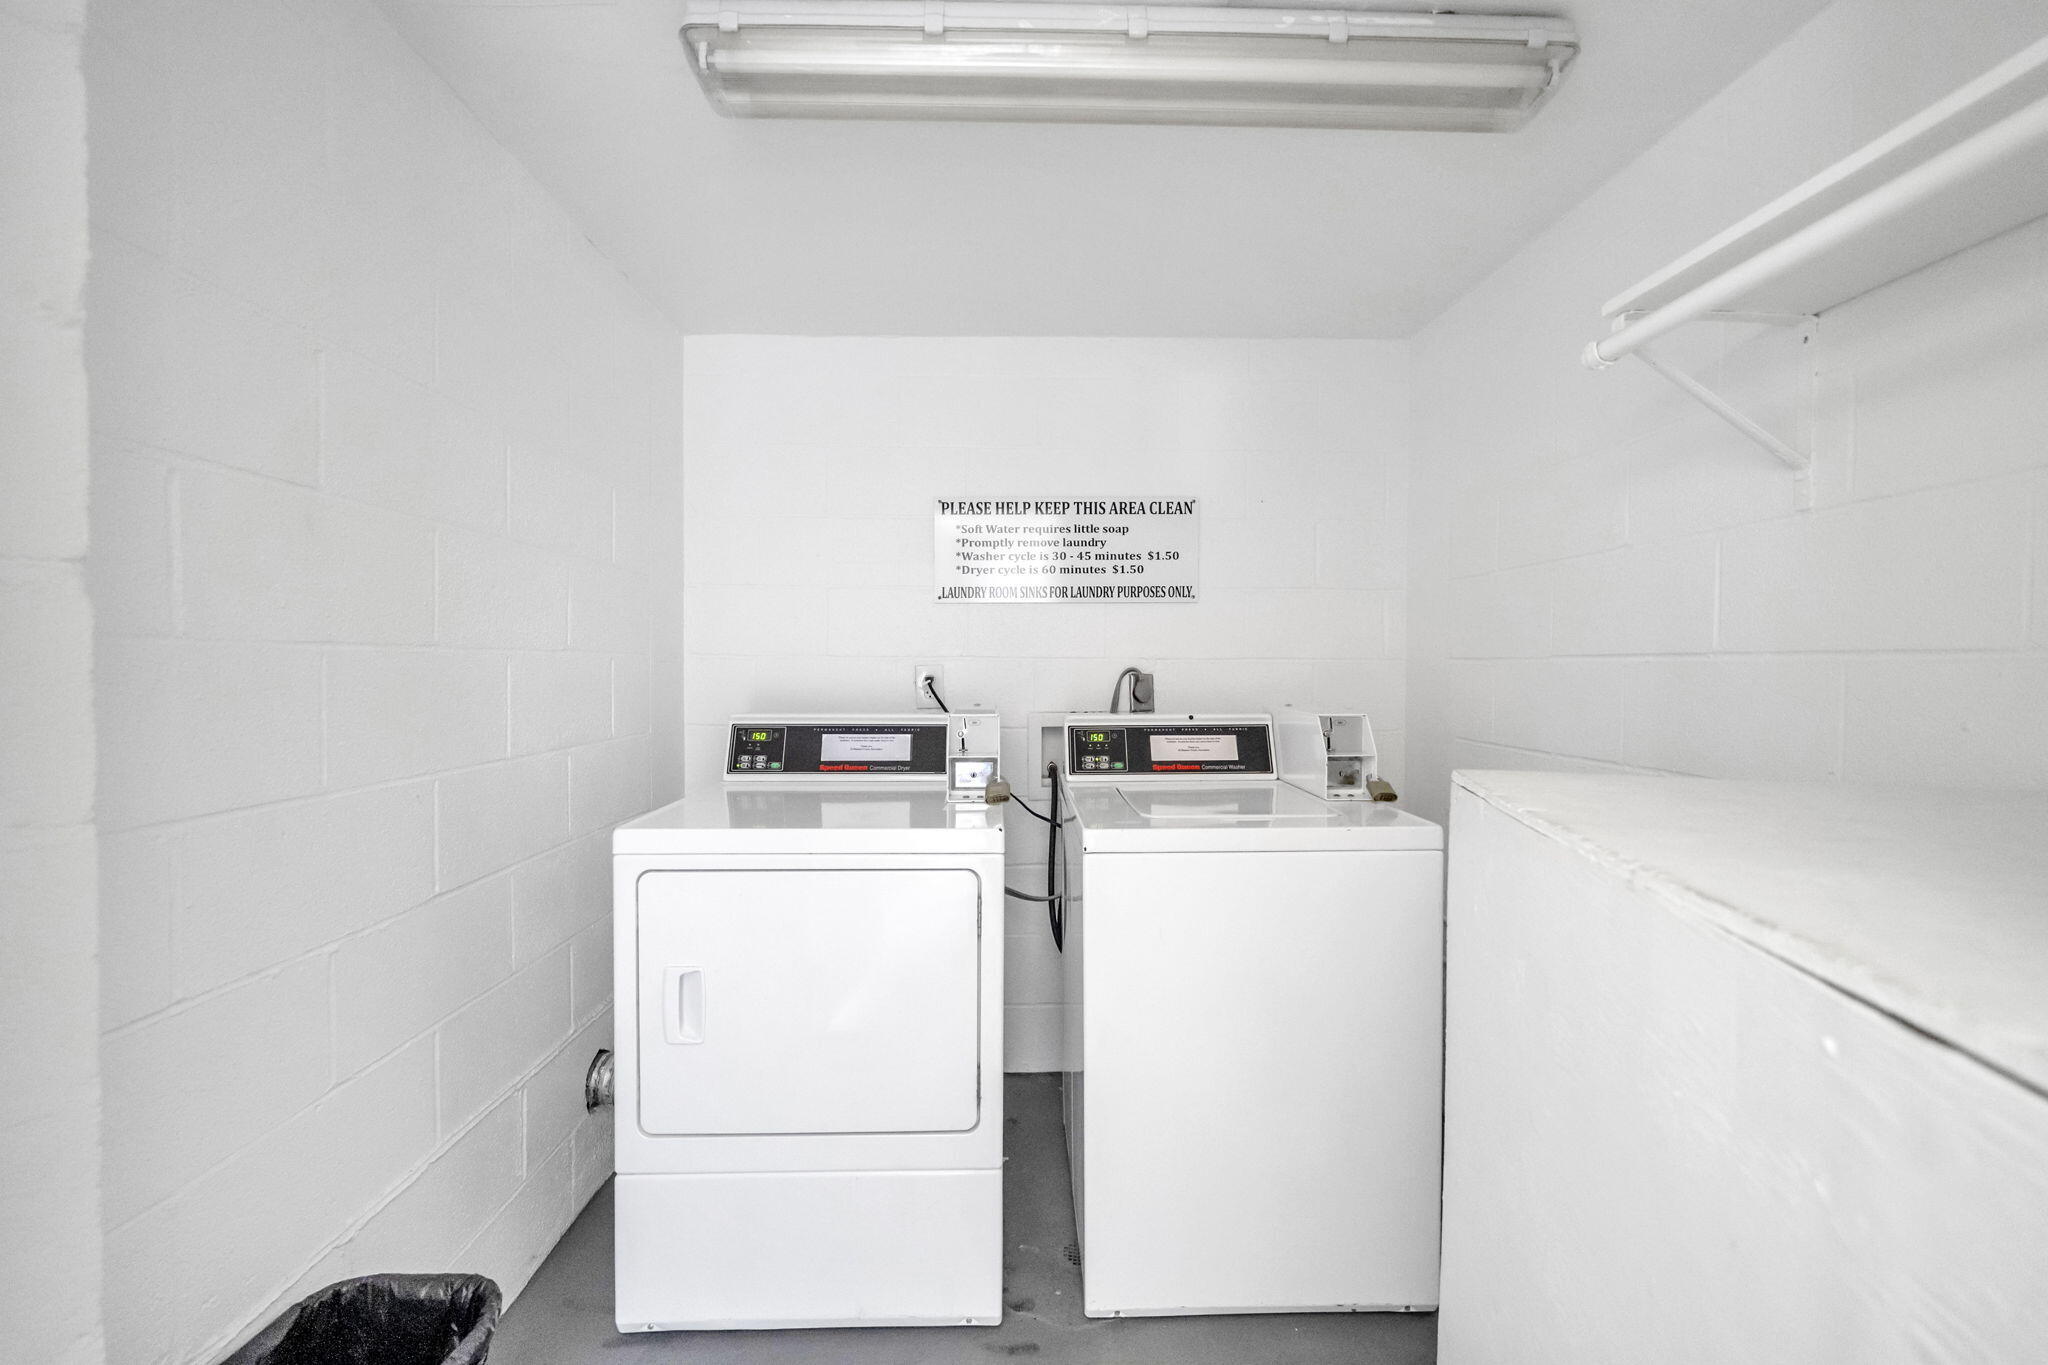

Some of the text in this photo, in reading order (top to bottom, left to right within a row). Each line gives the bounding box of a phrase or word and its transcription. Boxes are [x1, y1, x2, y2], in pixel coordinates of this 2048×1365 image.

[941, 501, 1193, 515] PLEASE HELP KEEP THIS AREA CLEAN
[986, 524, 1020, 534] Water
[1023, 525, 1071, 536] requires
[1073, 524, 1100, 533] little
[1102, 525, 1129, 535] soap
[1062, 538, 1107, 549] laundry
[1008, 552, 1036, 563] cycle
[1039, 552, 1049, 560] is
[1051, 551, 1067, 561] 30
[1076, 551, 1091, 561] 45
[1094, 551, 1142, 560] minutes
[1147, 551, 1180, 561] $1.50
[998, 565, 1026, 576] cycle
[1029, 565, 1039, 574] is
[1041, 564, 1056, 574] 60
[1059, 565, 1107, 574] minutes
[1112, 564, 1144, 574] $1.50
[941, 586, 987, 598] LAUNDRY
[989, 586, 1018, 598] ROOM
[1019, 586, 1048, 598] SINKS
[1049, 586, 1069, 598] FOR
[1070, 586, 1116, 598] LAUNDRY
[1117, 586, 1166, 598] PURPOSES
